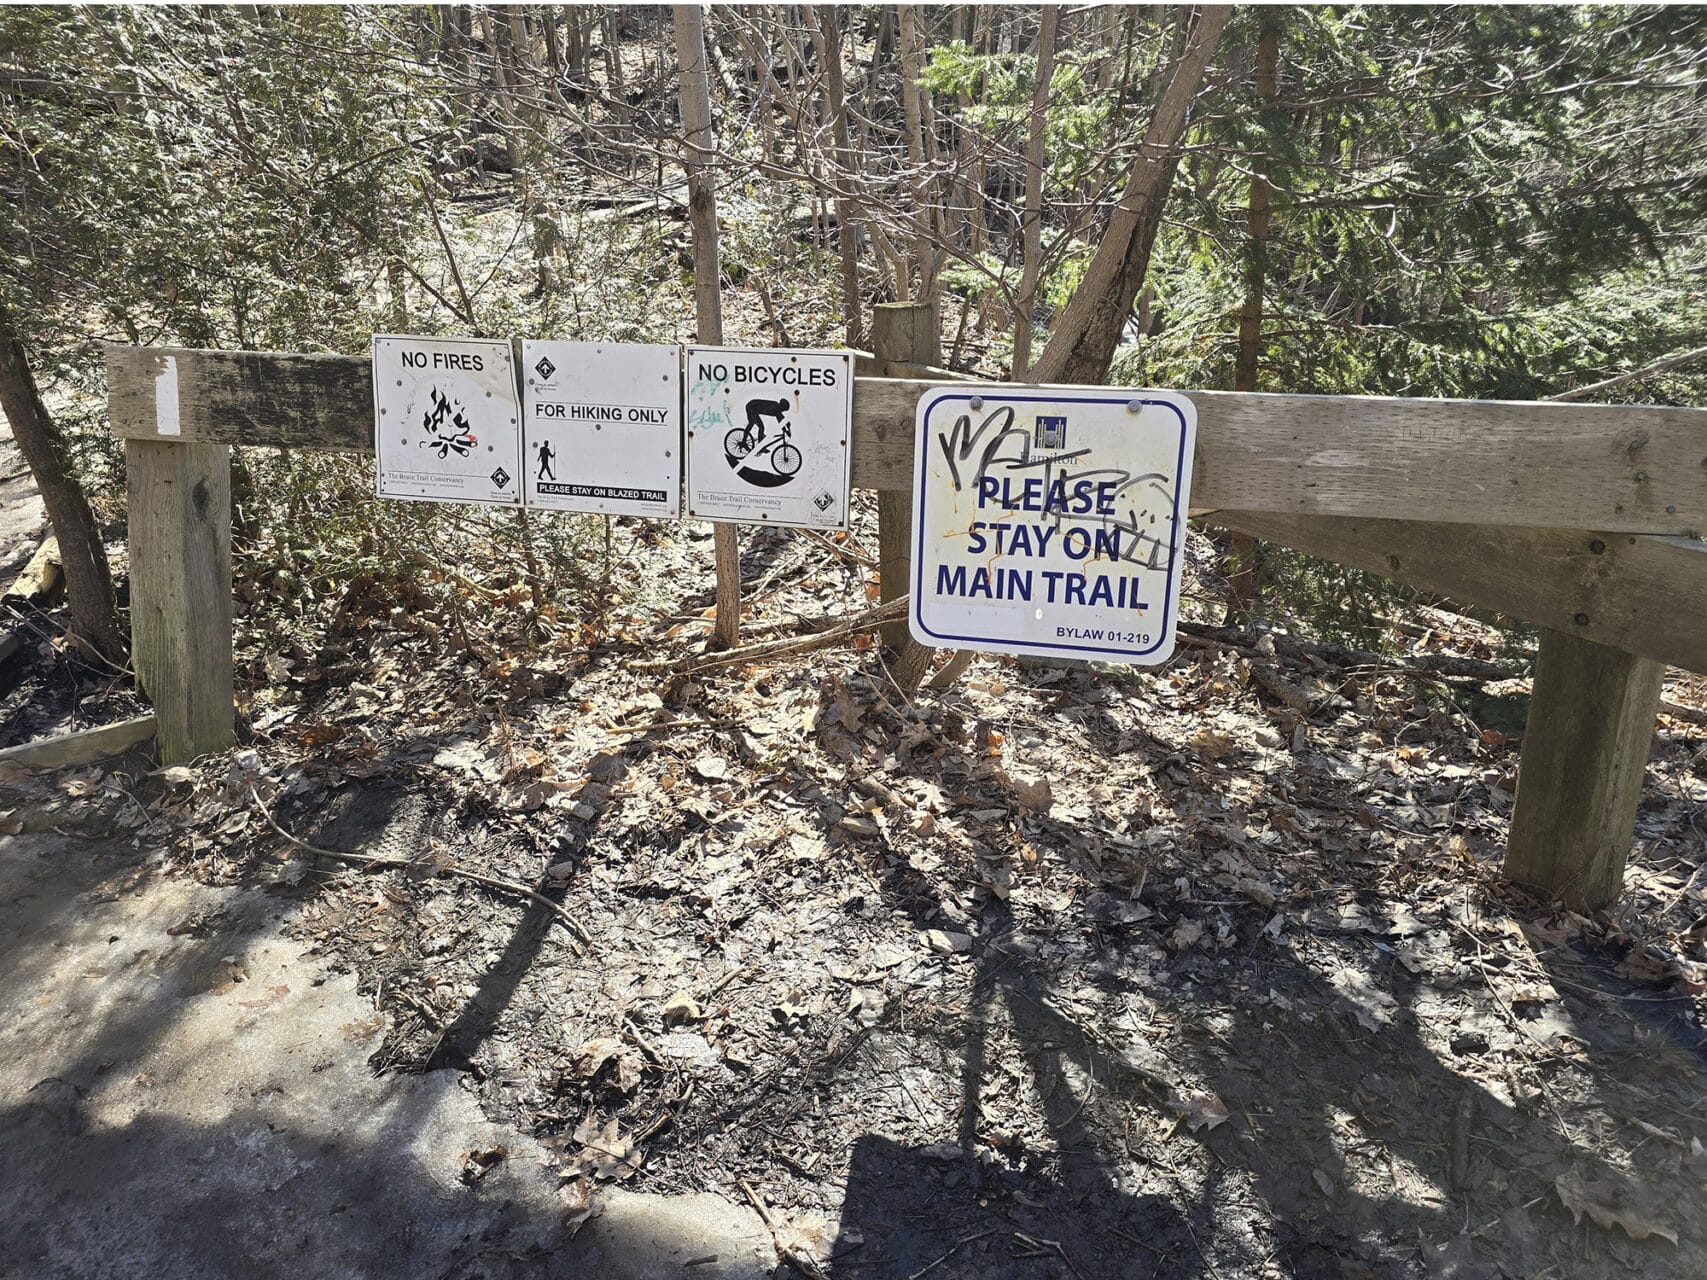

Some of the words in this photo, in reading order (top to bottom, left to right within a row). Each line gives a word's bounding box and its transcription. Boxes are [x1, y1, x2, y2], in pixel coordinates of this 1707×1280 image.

[401, 351, 428, 368] NO
[433, 352, 484, 371] FIRES
[699, 363, 728, 382] NO
[734, 365, 836, 386] BICYCLES
[535, 403, 566, 418] FOR
[571, 405, 622, 421] HIKING
[628, 408, 668, 423] ONLY
[539, 484, 570, 494] PLEASE
[572, 485, 592, 495] STAY
[593, 487, 606, 496] ON
[607, 488, 640, 499] BLAZED
[641, 491, 665, 500] TRAIL
[978, 476, 1118, 516] PLEASE
[966, 521, 1057, 558] STAY
[1062, 527, 1121, 562] ON
[936, 564, 1033, 601] MAIN
[1041, 571, 1149, 610] TRAIL
[1056, 626, 1104, 640] BYLAW
[1107, 631, 1150, 644] 01-219
